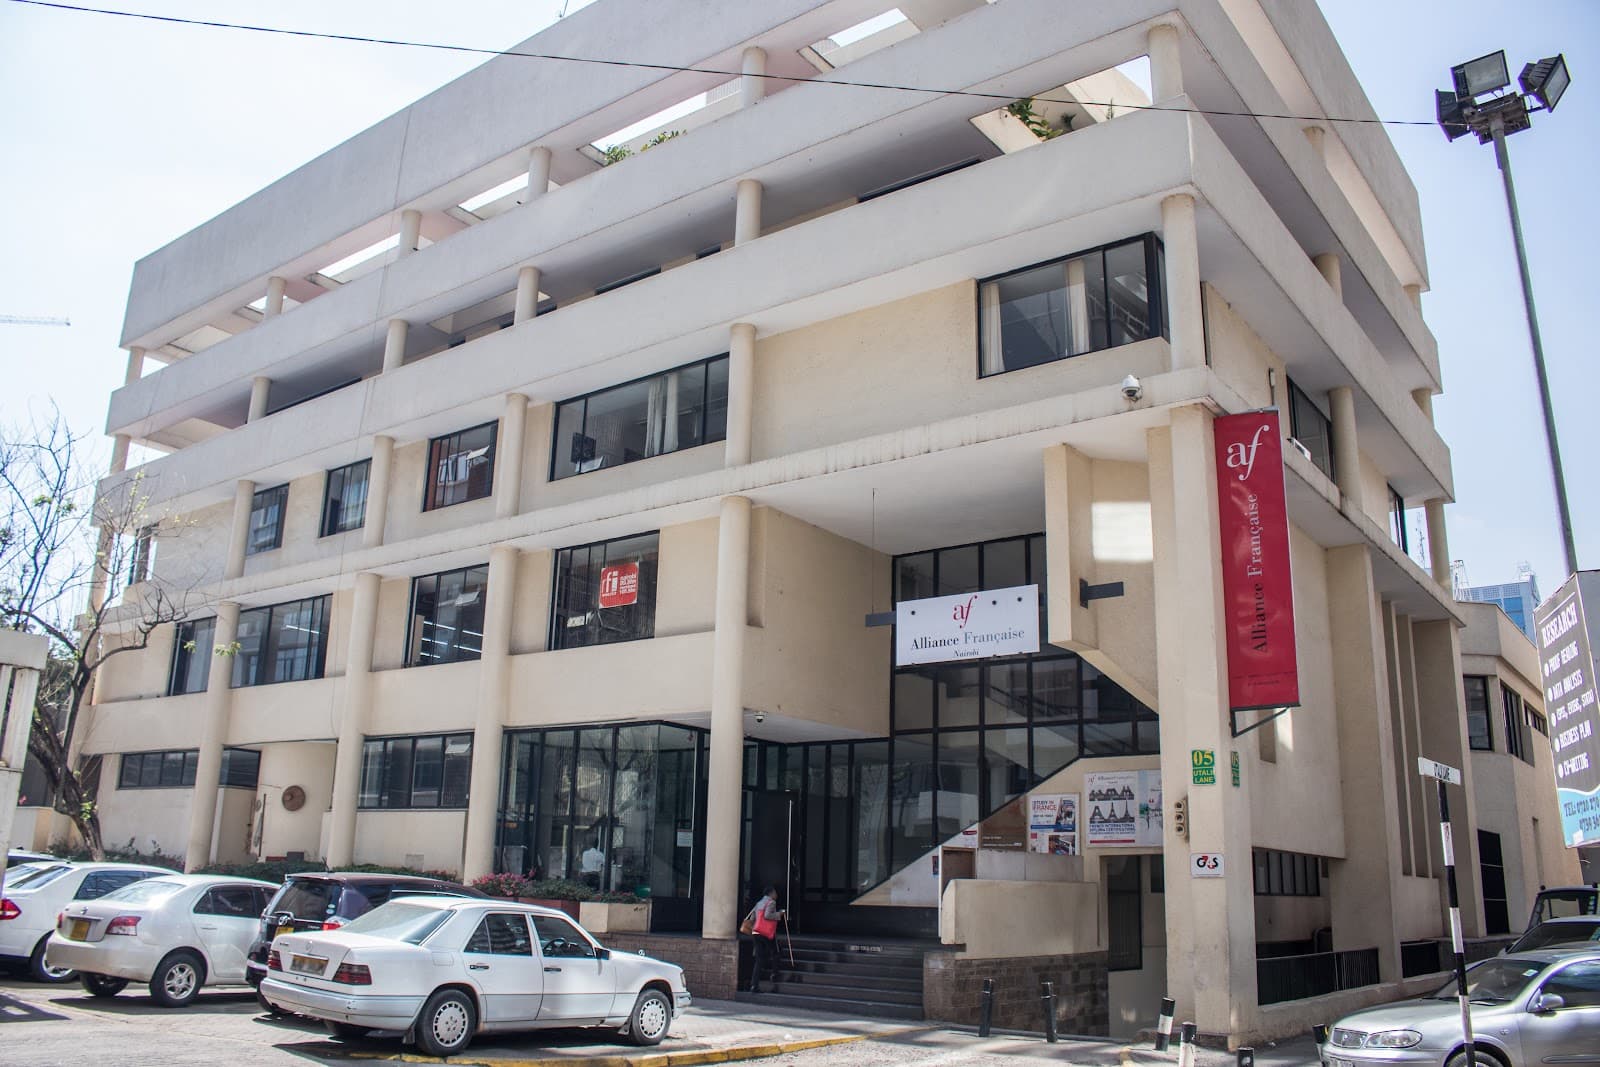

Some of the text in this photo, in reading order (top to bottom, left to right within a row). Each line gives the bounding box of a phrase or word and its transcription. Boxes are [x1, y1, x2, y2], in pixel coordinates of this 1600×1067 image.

[1226, 424, 1269, 480] af
[602, 571, 618, 593] rfi
[1245, 494, 1267, 653] Alliance Française
[953, 595, 977, 628] af
[1541, 602, 1578, 648] RESEARCH
[911, 627, 1024, 650] Alliance Française
[954, 649, 979, 657] Nairobi
[1552, 668, 1583, 700] DATA ANALYSIS
[1560, 720, 1592, 749] BUSINESS PLAN
[1193, 751, 1213, 766] 05
[1564, 802, 1576, 817] TEL:
[1196, 855, 1218, 869] G4S
